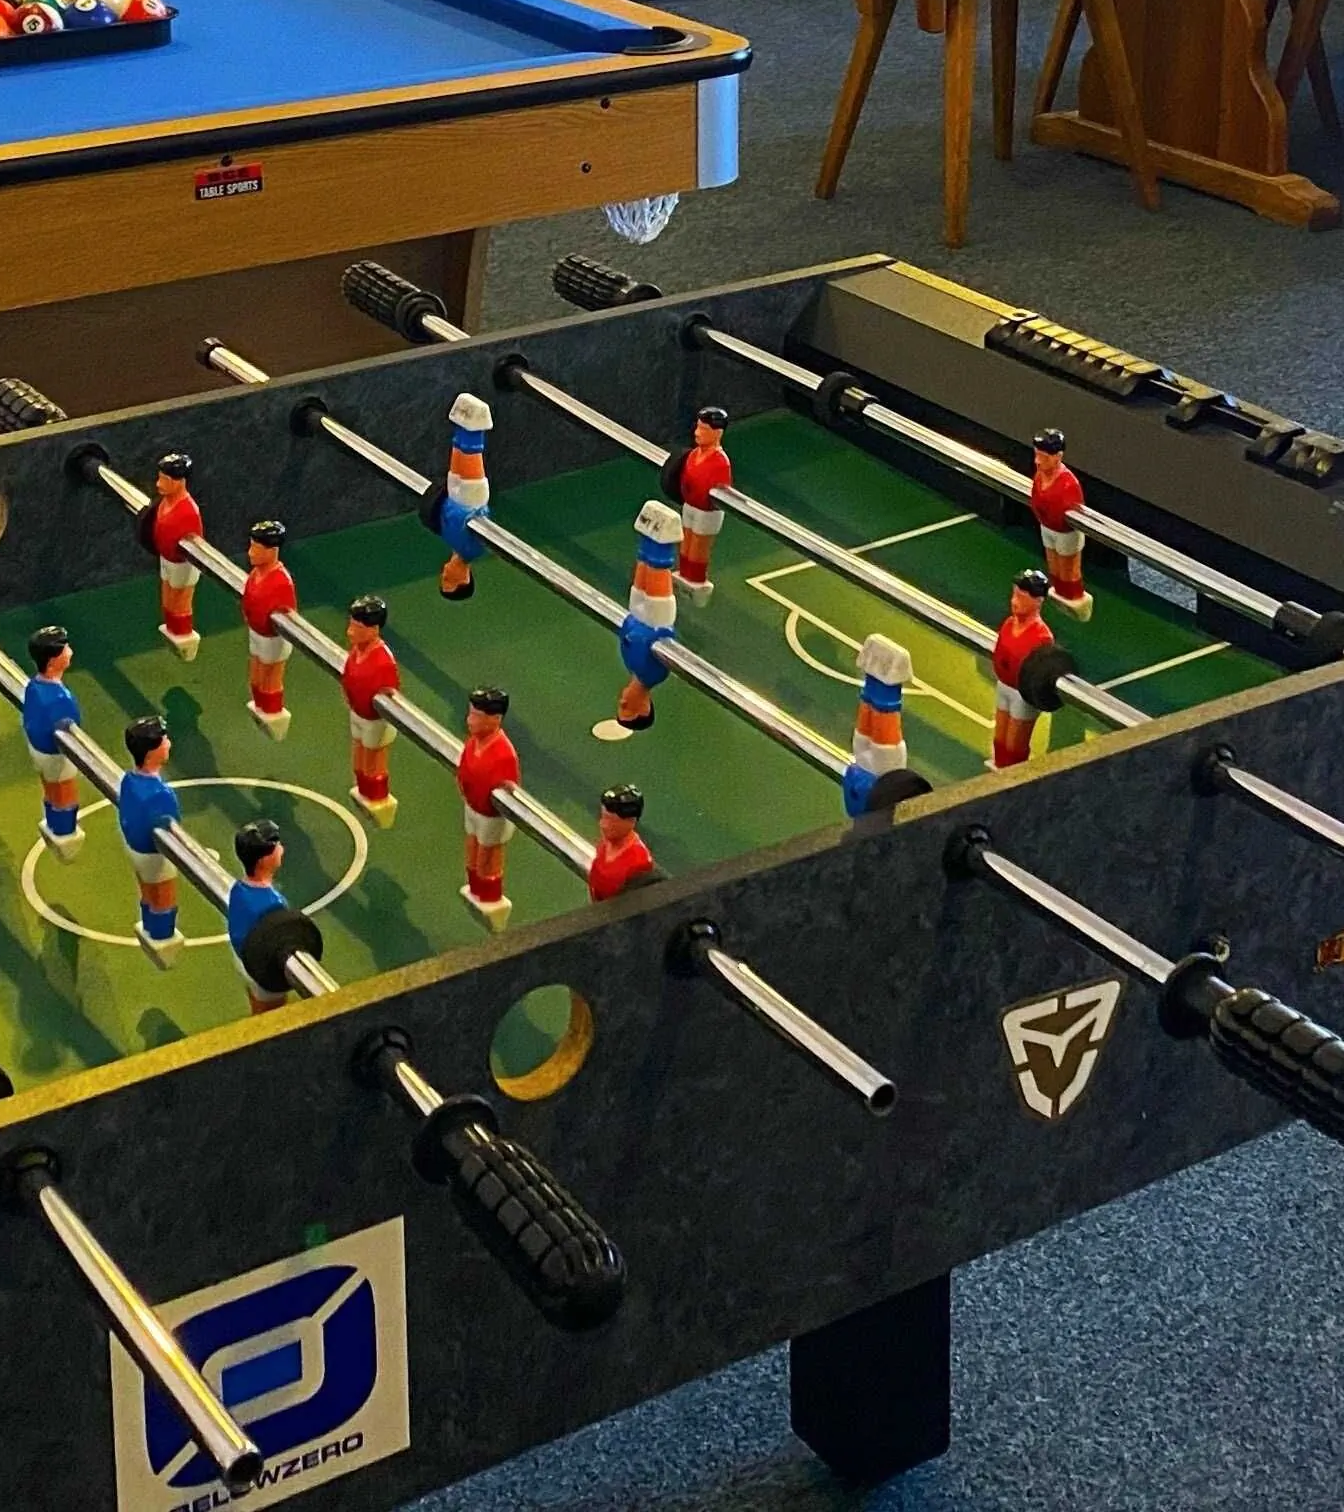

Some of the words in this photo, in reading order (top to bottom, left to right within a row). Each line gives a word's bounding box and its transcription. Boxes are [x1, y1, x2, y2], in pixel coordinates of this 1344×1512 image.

[200, 184, 225, 199] TABLE
[226, 179, 259, 195] SPORTS
[169, 1431, 365, 1512] ELWZERO
